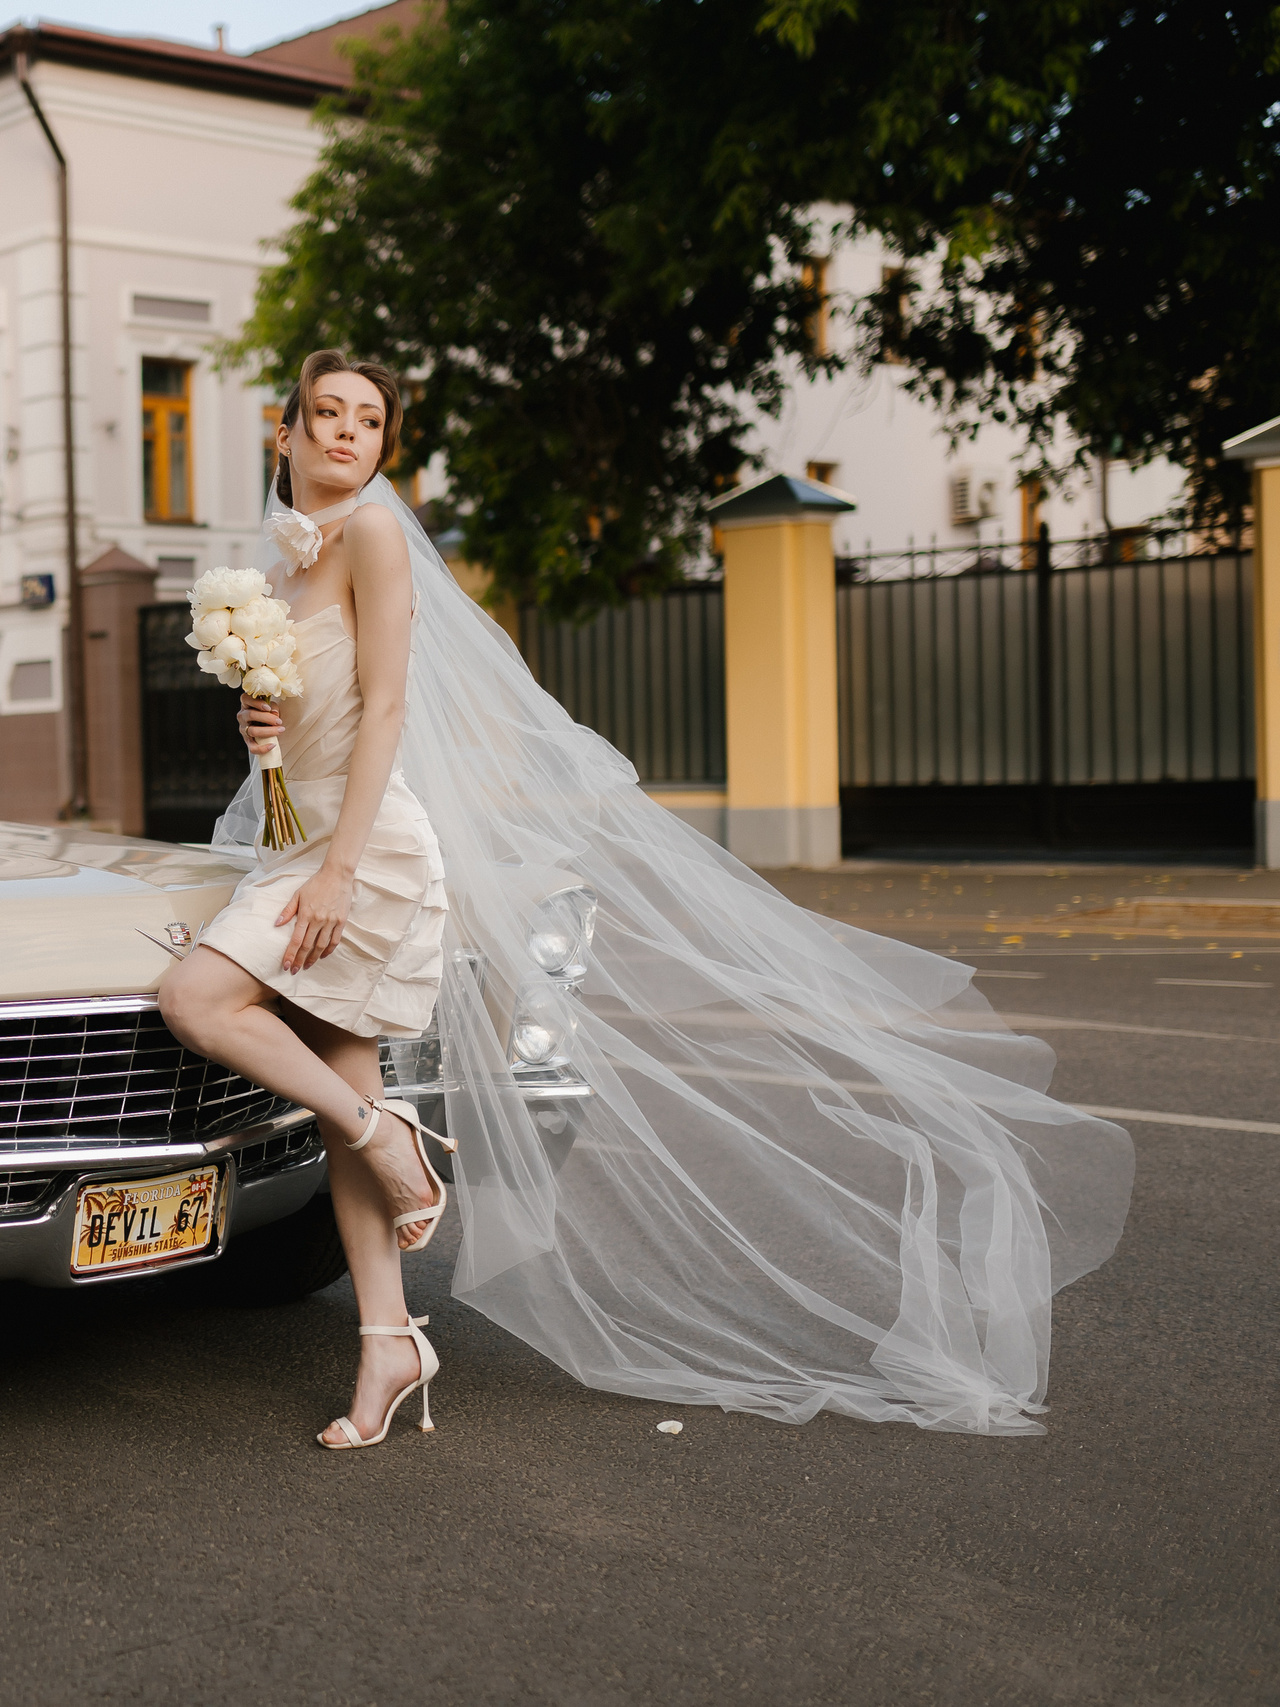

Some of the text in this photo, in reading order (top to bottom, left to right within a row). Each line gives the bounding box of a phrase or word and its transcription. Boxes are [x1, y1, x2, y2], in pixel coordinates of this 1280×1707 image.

[123, 1185, 181, 1206] FLORIDA
[88, 1196, 204, 1248] DEVIL 67
[111, 1237, 179, 1260] SUNSHINE STATE
